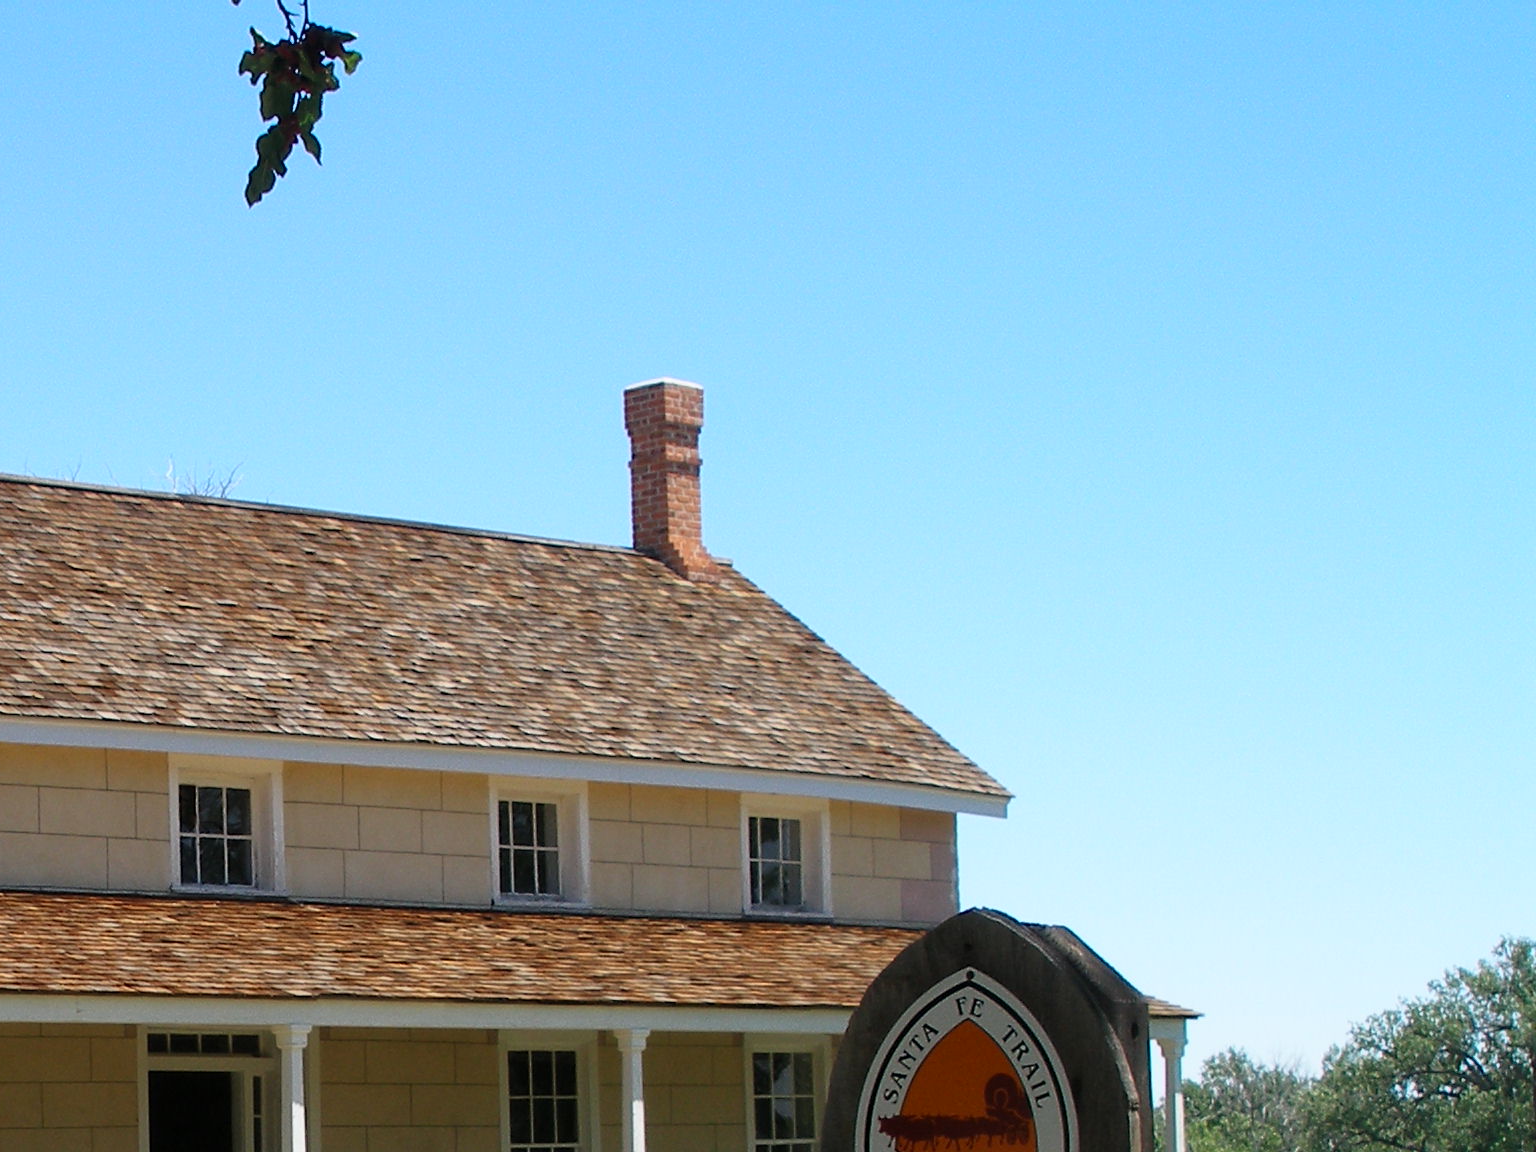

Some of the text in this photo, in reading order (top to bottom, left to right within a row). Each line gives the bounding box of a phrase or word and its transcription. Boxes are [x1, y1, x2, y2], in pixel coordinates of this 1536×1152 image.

[884, 996, 1052, 1108] SANTA FE TRAIL
